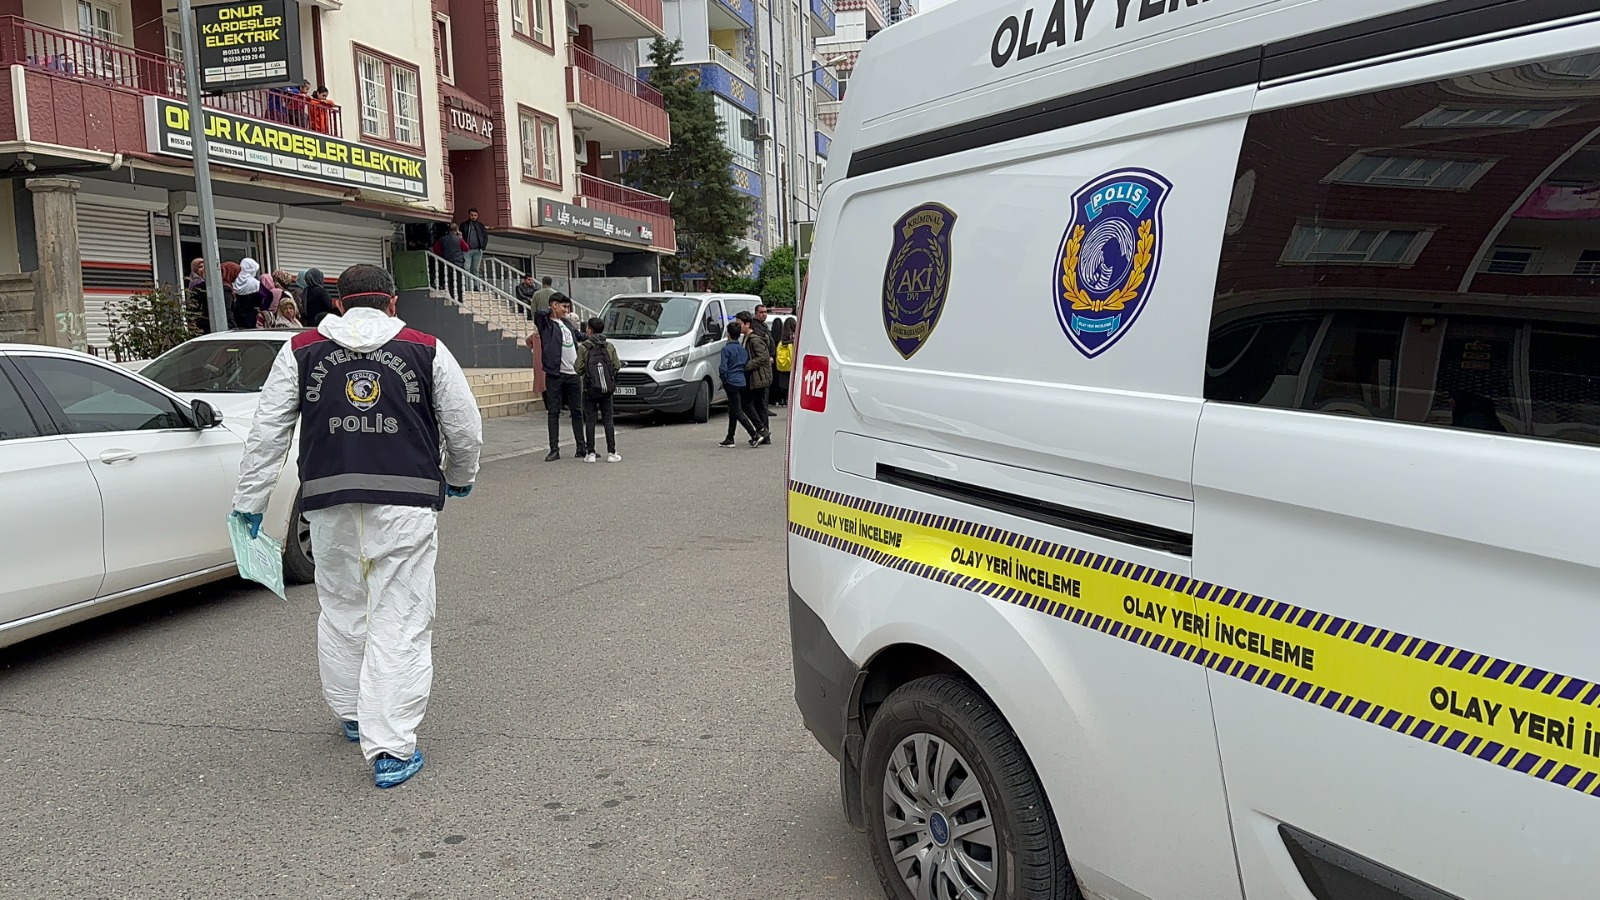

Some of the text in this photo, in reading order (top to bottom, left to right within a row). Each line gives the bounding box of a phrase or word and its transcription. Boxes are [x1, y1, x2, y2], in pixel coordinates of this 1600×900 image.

[202, 16, 282, 34] KARDEŞLER
[219, 4, 263, 20] ONUR
[991, 0, 1095, 68] OLAY
[165, 105, 232, 140] OUR
[235, 121, 349, 164] KARDEŞLER
[451, 109, 493, 138] TUBA AP
[1092, 183, 1144, 208] POLİS
[908, 212, 941, 228] KRİMİNAL
[896, 263, 933, 293] AKİ
[306, 361, 329, 402] OLAY
[804, 370, 824, 398] 112
[328, 414, 398, 434] POLİS
[817, 510, 902, 548] OLAY YERİ İNCELEME
[950, 546, 1081, 598] OLAY YERİ İNCELEME
[1123, 595, 1315, 671] OLAY YERİ İNCELEME
[1430, 686, 1502, 726] OLAY
[1508, 707, 1574, 750] YERİ
